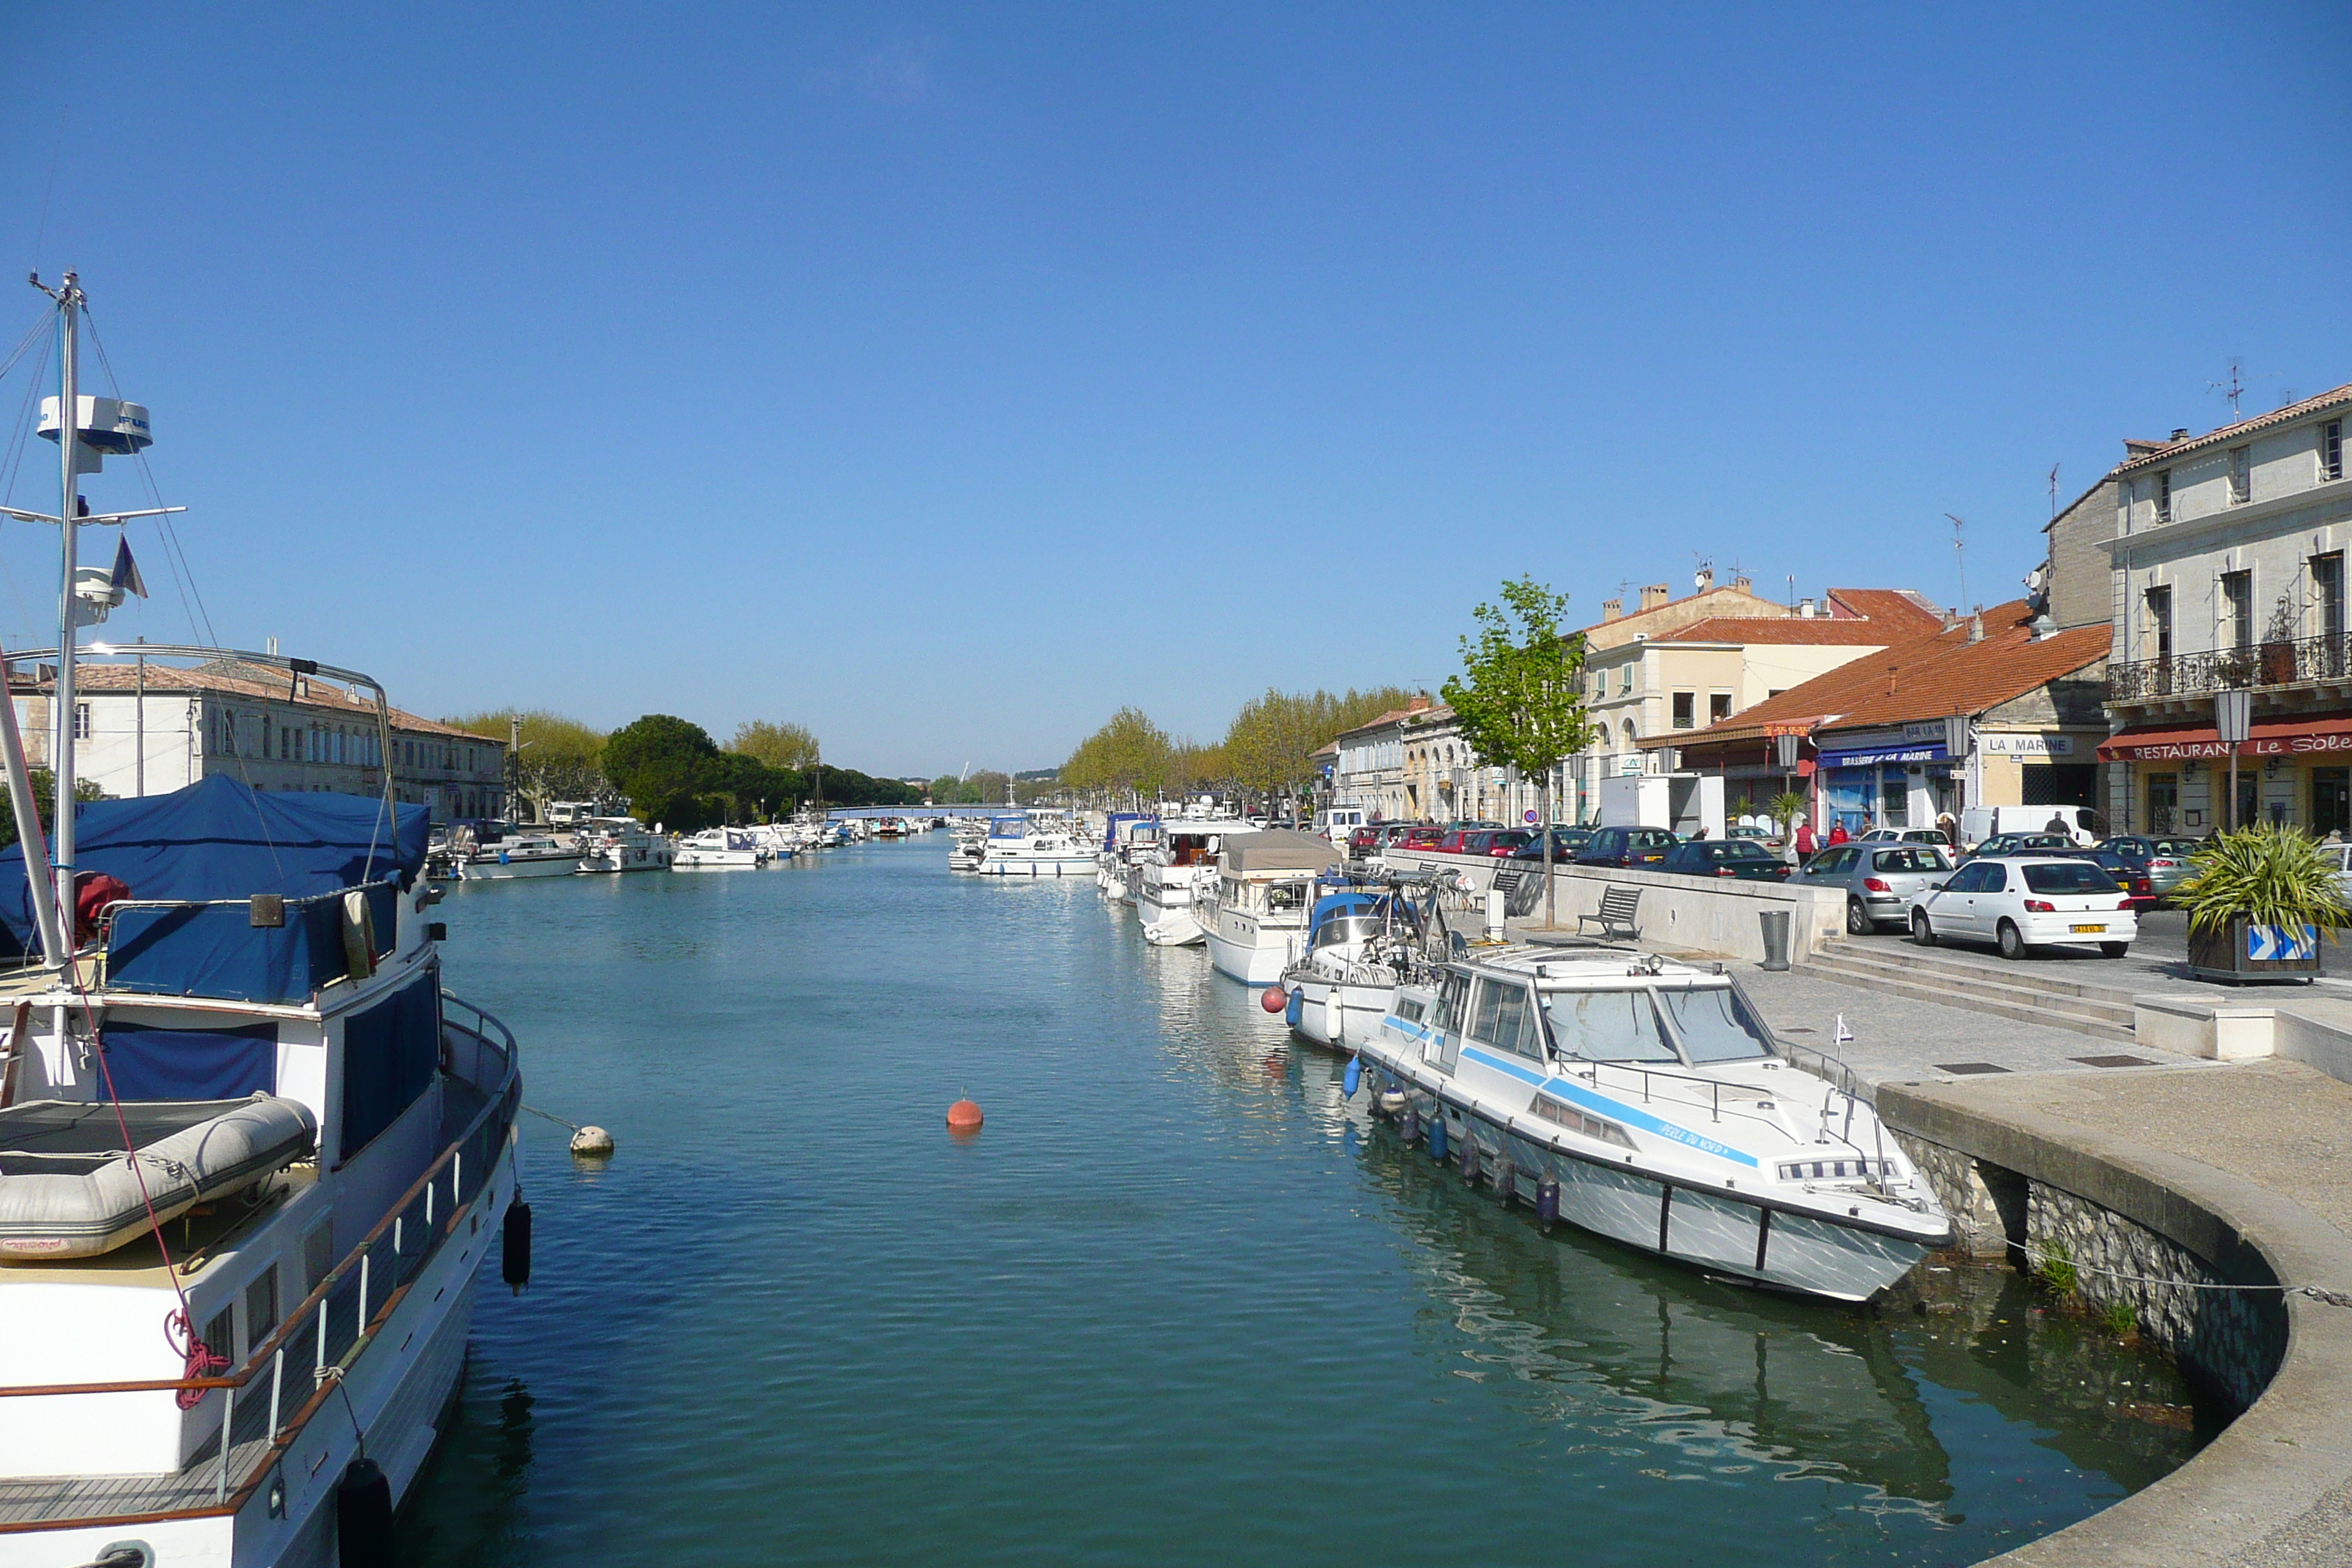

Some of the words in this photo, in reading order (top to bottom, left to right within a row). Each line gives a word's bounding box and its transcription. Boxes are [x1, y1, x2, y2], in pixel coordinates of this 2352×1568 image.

[1989, 739, 2006, 750] LA
[2016, 739, 2067, 751] MARINE
[1842, 755, 1875, 766] BRASSERIE
[1900, 750, 1932, 761] MARINE
[1660, 1124, 1686, 1141] PERLE
[1686, 1134, 1698, 1145] DU
[1700, 1139, 1723, 1153] NORD
